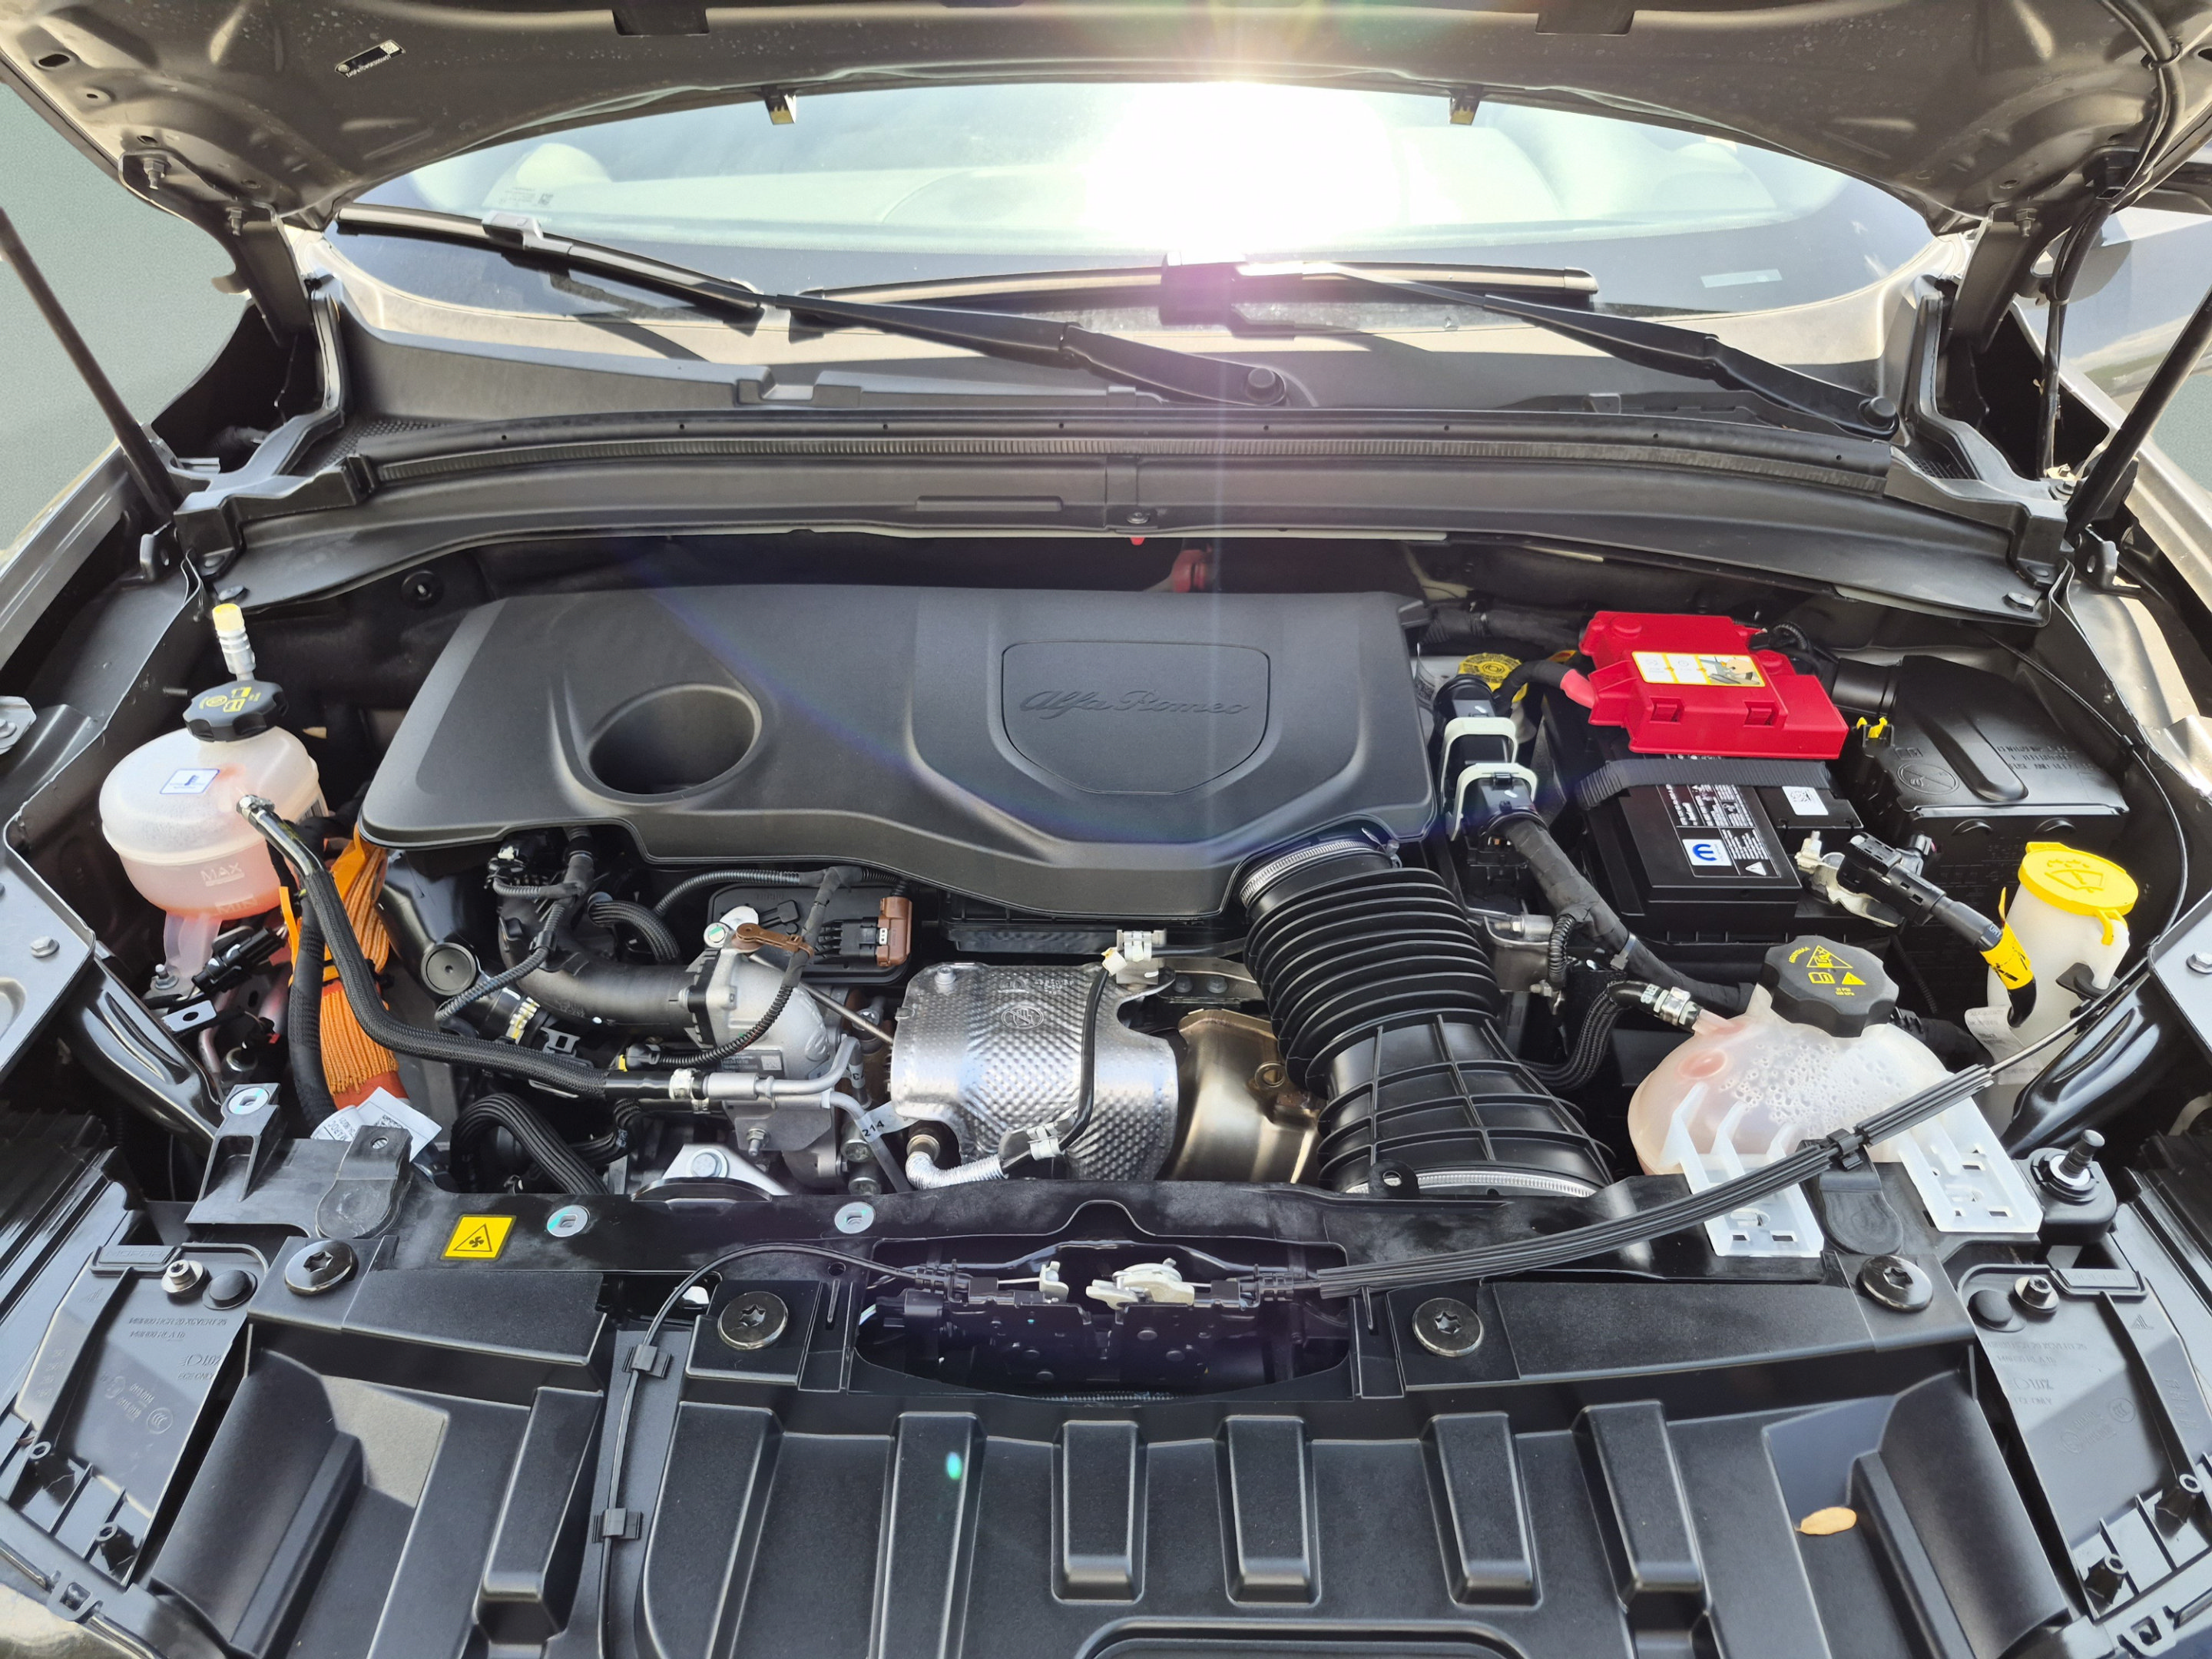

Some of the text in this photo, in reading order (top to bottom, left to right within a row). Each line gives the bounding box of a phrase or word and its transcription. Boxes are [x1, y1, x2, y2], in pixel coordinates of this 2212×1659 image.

[1019, 689, 1251, 720] Alfa Romeo
[200, 862, 243, 882] MAX
[861, 1120, 885, 1137] 214
